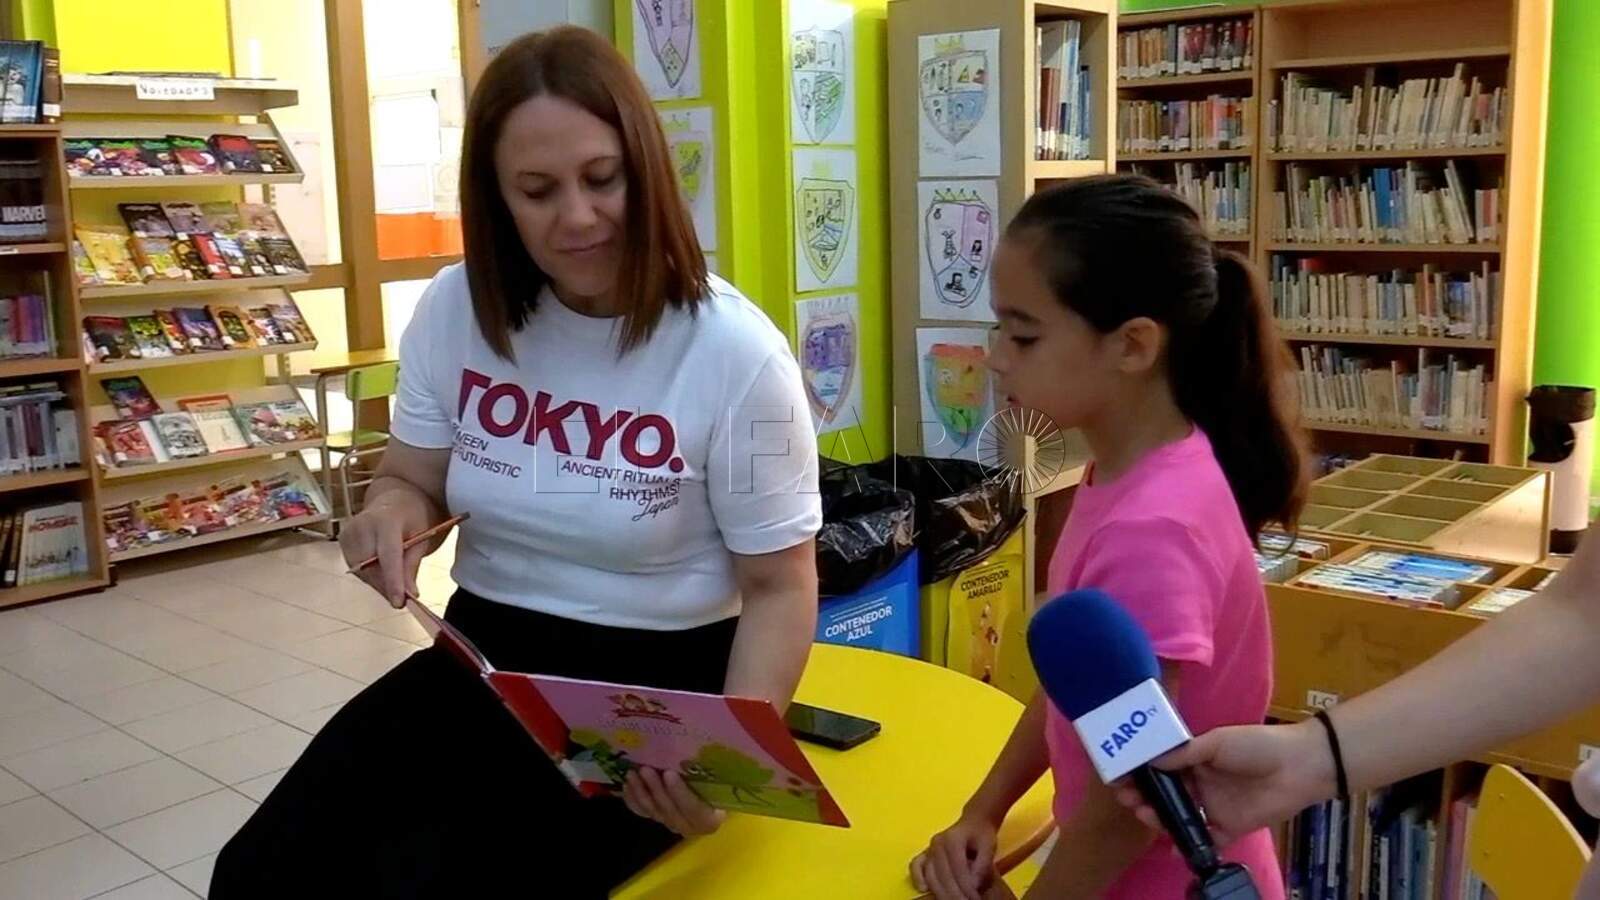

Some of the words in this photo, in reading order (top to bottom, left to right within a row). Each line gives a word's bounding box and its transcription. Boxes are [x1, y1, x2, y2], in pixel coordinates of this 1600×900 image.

[457, 368, 685, 473] TOKYO.
[561, 460, 622, 480] ANCIENT
[961, 570, 1010, 592] CONTENEDOR
[967, 582, 1003, 600] AMARILLO
[825, 605, 893, 638] CONTENEDOR
[846, 624, 873, 642] AZUL
[1101, 710, 1148, 758] FARO
